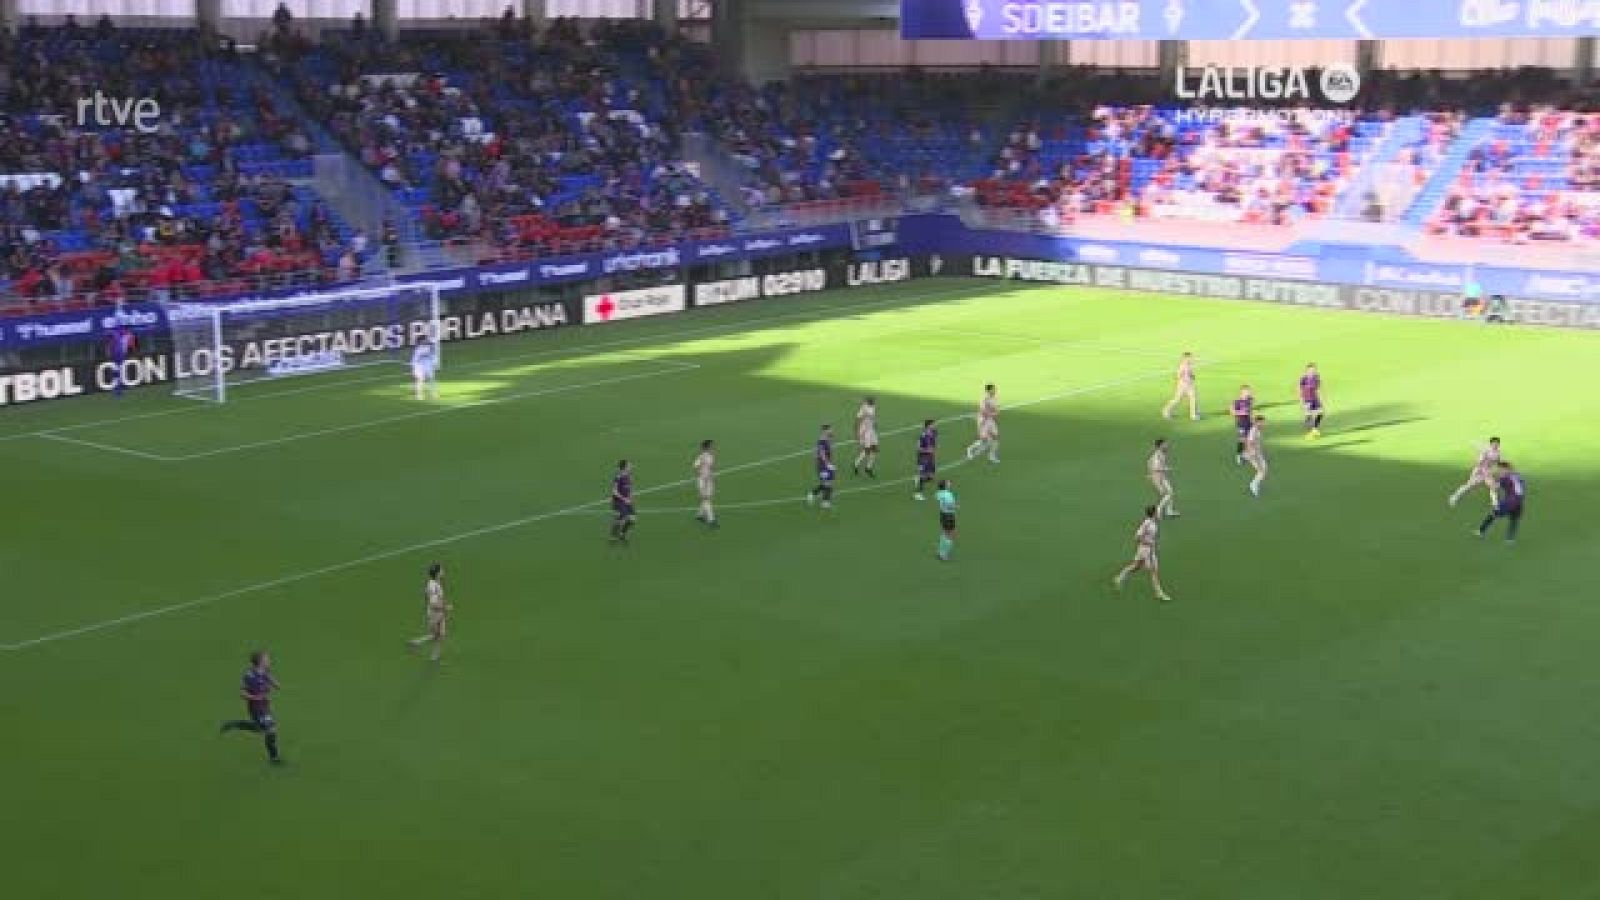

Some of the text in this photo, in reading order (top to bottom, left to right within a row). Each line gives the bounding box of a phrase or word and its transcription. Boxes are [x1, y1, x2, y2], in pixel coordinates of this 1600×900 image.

[96, 355, 167, 390] CON
[174, 345, 235, 379] LOS
[241, 323, 404, 370] AFECTADOS
[465, 311, 497, 339] LA
[501, 302, 567, 333] DANA
